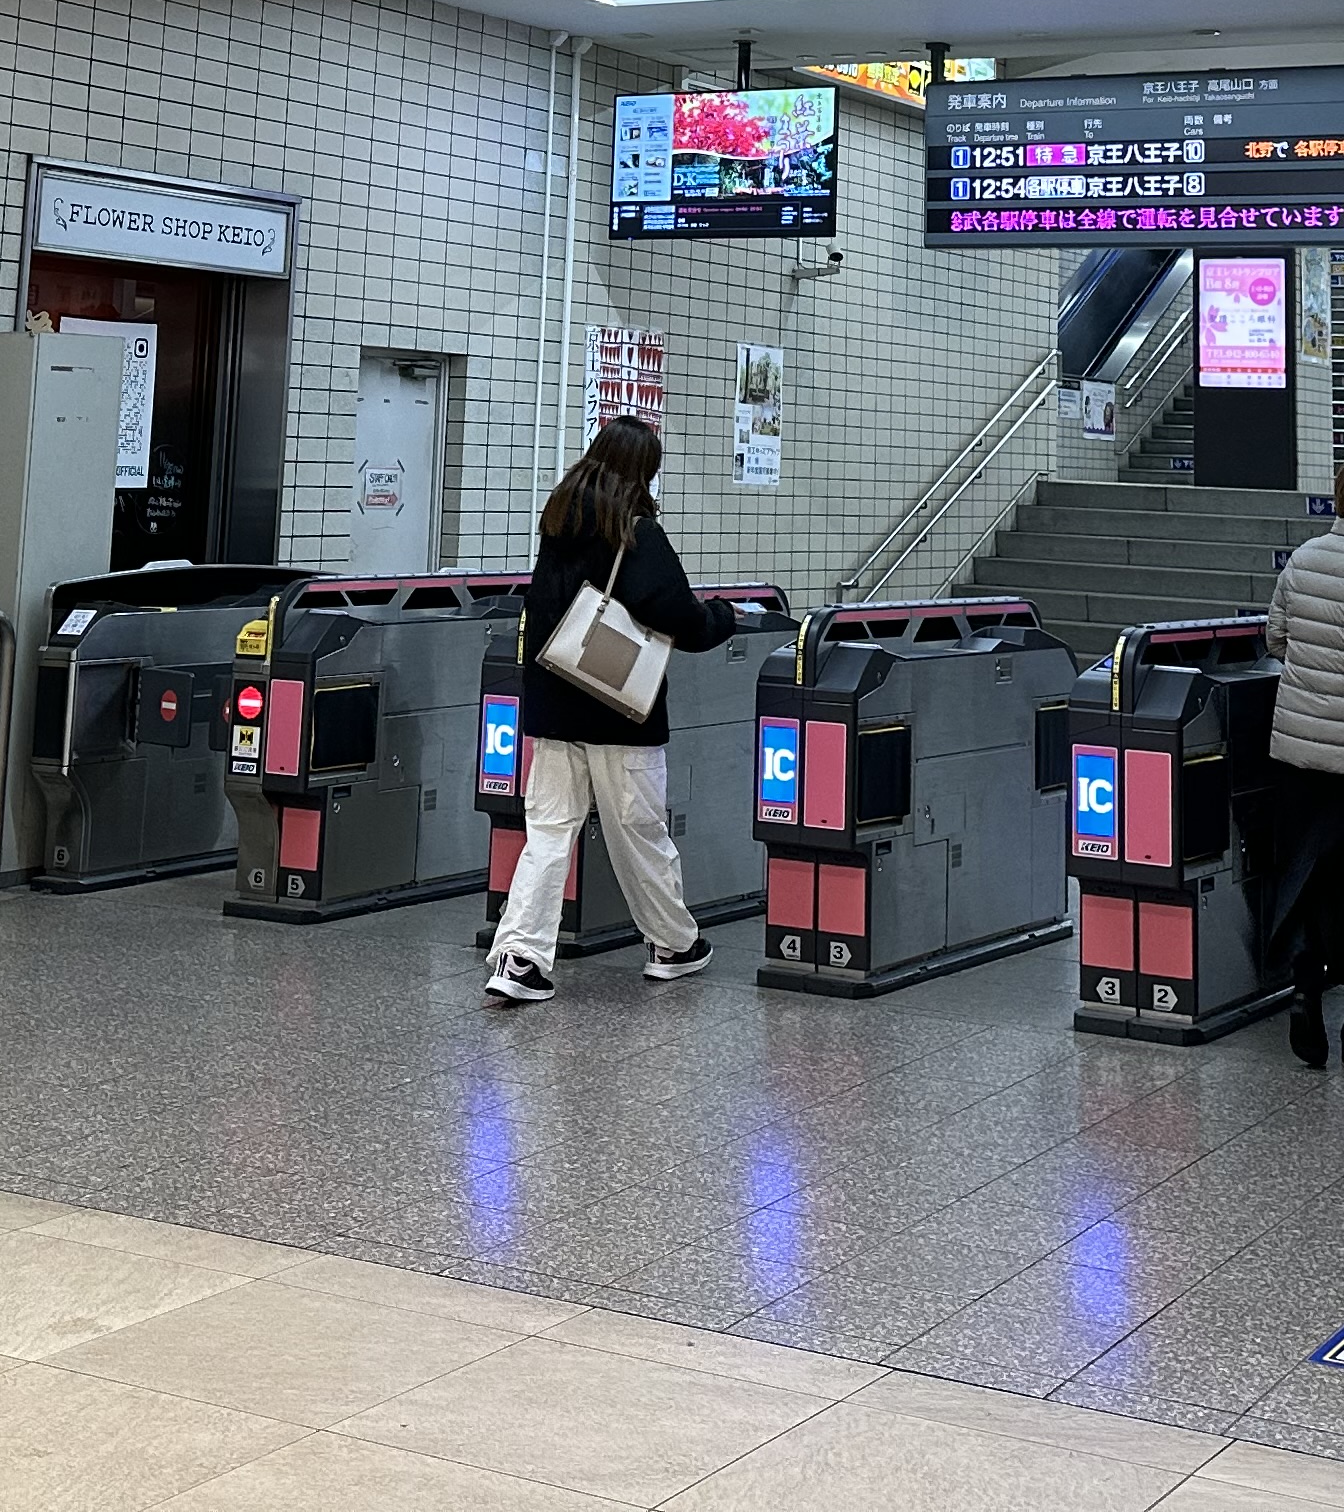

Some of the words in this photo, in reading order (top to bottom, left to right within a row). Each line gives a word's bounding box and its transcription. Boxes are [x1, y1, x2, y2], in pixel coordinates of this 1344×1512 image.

[1143, 80, 1199, 94] 京王八王子
[1207, 78, 1254, 92] 高尾山口
[1259, 79, 1278, 90] 方面
[948, 93, 1006, 110] 発車案内
[1020, 98, 1064, 109] Departure
[1067, 96, 1116, 106] Information
[1084, 119, 1102, 129] 行先
[1026, 132, 1045, 141] Train
[1084, 131, 1094, 139] To
[1184, 127, 1203, 136] Cars
[973, 147, 1024, 168] 12:51
[1087, 144, 1182, 166] 京王八王子
[973, 178, 1026, 199] 12:54
[1087, 176, 1182, 197] 京王八王子
[69, 203, 154, 232] FLOWER
[161, 217, 213, 239] SHOP
[218, 225, 265, 247] KEIO
[487, 724, 514, 756] IC
[764, 747, 794, 781] IC
[1077, 777, 1112, 813] IC
[764, 808, 790, 819] KEIO
[1080, 842, 1110, 853] KEIO
[253, 870, 263, 885] 6
[289, 877, 299, 892] 5
[786, 938, 798, 953] 4
[832, 945, 844, 961] 3
[1103, 980, 1116, 996] 3
[1157, 988, 1169, 1004] 2
